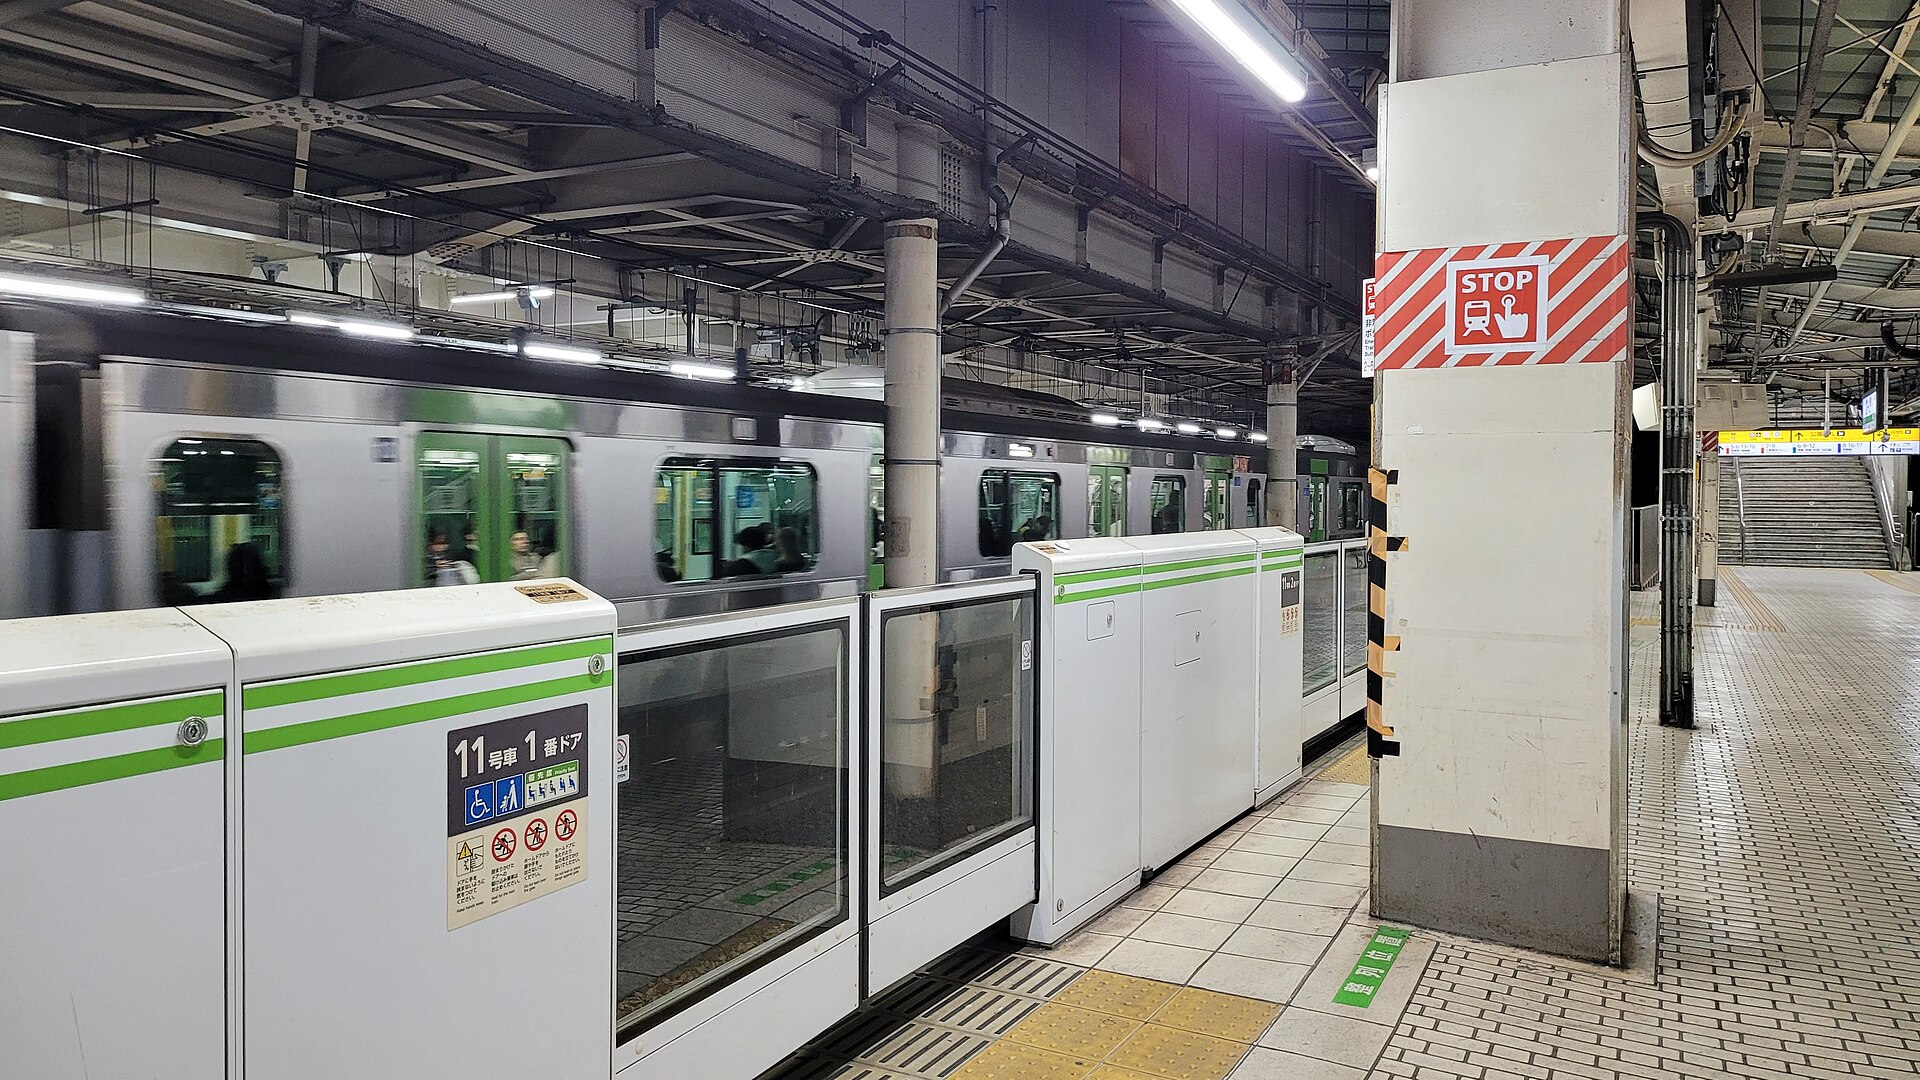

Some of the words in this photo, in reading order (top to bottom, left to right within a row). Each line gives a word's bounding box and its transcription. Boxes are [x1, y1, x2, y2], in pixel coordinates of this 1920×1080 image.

[1461, 270, 1533, 293] STOP
[454, 735, 517, 778] 11号車
[524, 730, 583, 761] 1番ドア
